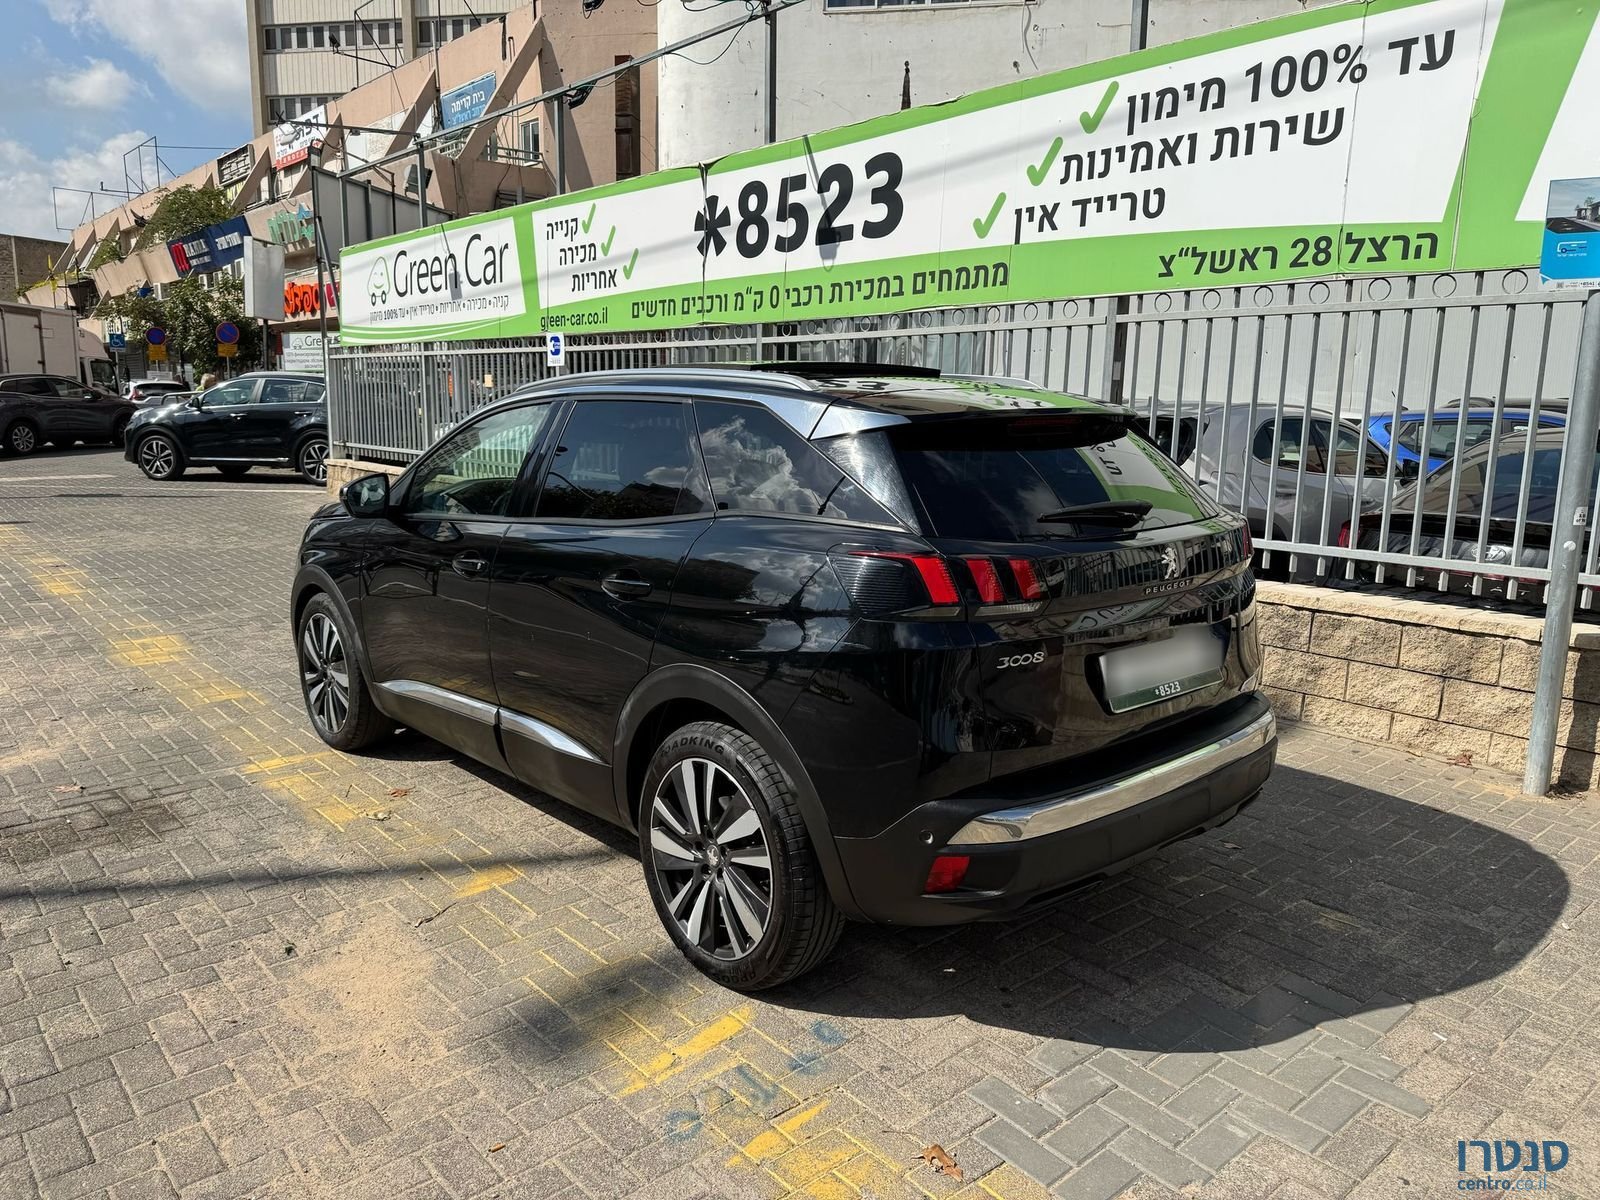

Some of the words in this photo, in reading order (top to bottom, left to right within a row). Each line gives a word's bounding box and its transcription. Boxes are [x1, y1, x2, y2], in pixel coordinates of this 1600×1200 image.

[1388, 30, 1455, 76] עד
[1244, 44, 1368, 103] 100%
[1127, 77, 1226, 136] מימון
[1210, 106, 1345, 162] שירות
[1060, 132, 1197, 185] ואמינות
[1072, 187, 1166, 228] טרייד
[547, 217, 578, 242] קנייה
[1014, 202, 1059, 245] אין
[559, 242, 597, 266] מכירה
[1289, 235, 1332, 268] 28
[1345, 231, 1438, 264] הרצל
[393, 250, 458, 298] Green
[464, 233, 509, 287] Car
[913, 262, 1009, 295] מתמחים
[571, 268, 617, 293] אחריות
[829, 275, 905, 304] במכירת
[631, 298, 677, 319] חדשים
[682, 293, 729, 316] ורכבים
[769, 285, 780, 309] 0
[785, 285, 823, 308] רכבי
[383, 309, 399, 320] 100%
[541, 306, 608, 332] green-car.co.il
[305, 335, 322, 347] Gre
[1145, 579, 1191, 595] PEUGEOT
[997, 651, 1045, 669] 3008
